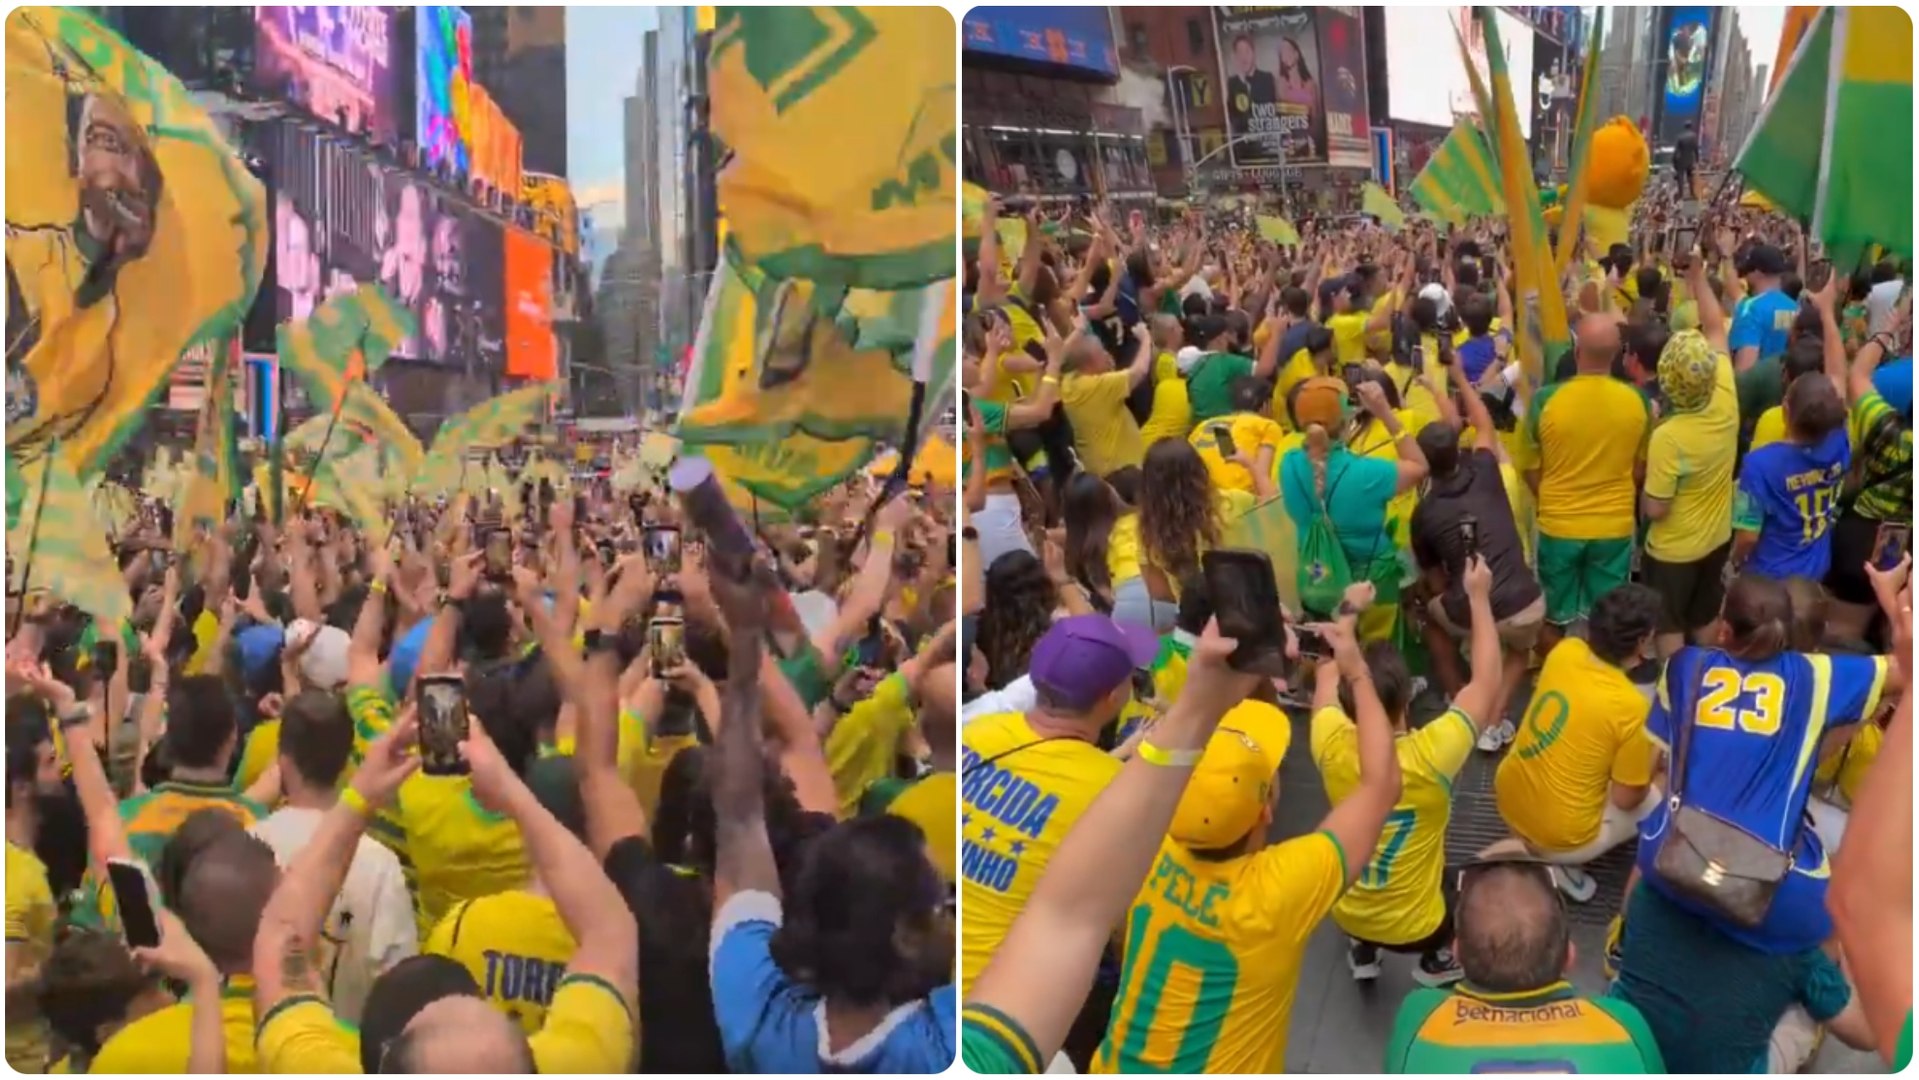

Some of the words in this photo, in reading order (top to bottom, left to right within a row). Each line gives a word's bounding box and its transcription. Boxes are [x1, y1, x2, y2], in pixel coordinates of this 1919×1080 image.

[1248, 115, 1309, 132] strangers
[1251, 101, 1276, 119] two
[1517, 690, 1569, 760] 9
[1695, 667, 1785, 736] 23
[962, 745, 1060, 839] ORCIDA
[1101, 902, 1238, 1074] 10
[1454, 1000, 1585, 1025] betnacional
